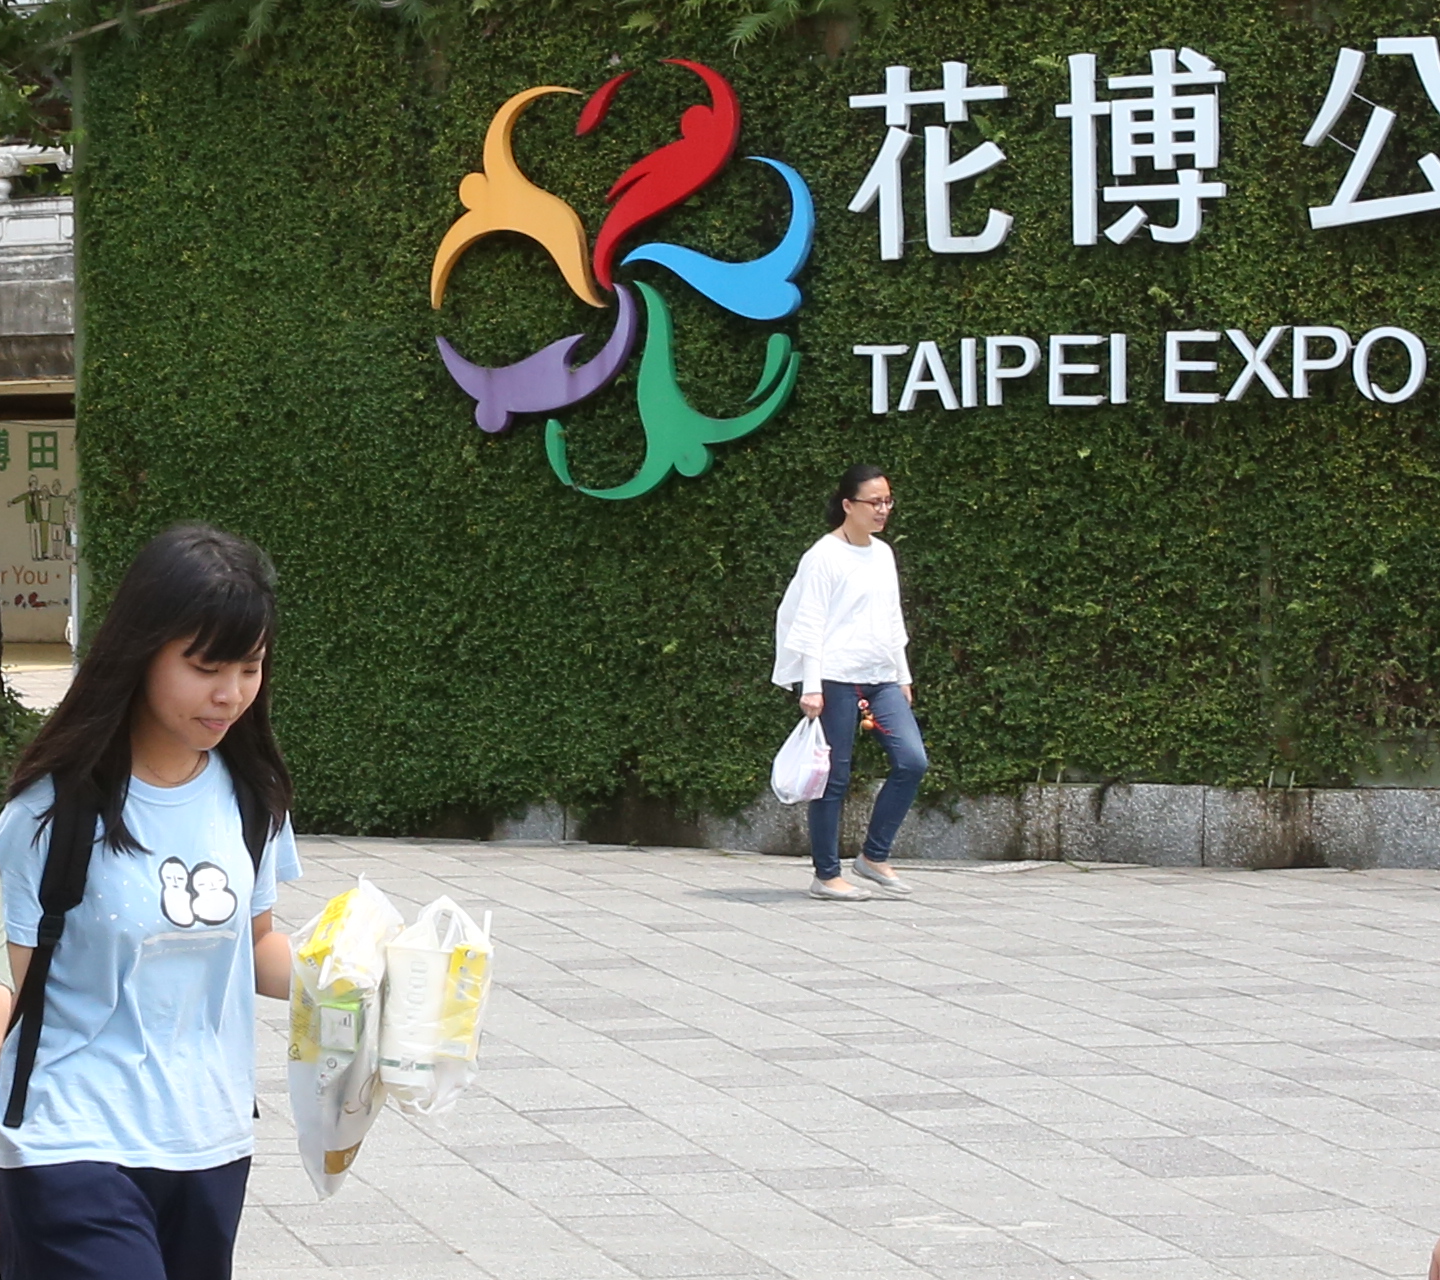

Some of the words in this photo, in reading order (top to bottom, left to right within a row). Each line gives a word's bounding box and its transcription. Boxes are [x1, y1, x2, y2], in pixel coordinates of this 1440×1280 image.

[853, 333, 1128, 416] TAIPEI
[1164, 324, 1428, 405] EXPO
[11, 565, 49, 585] You
